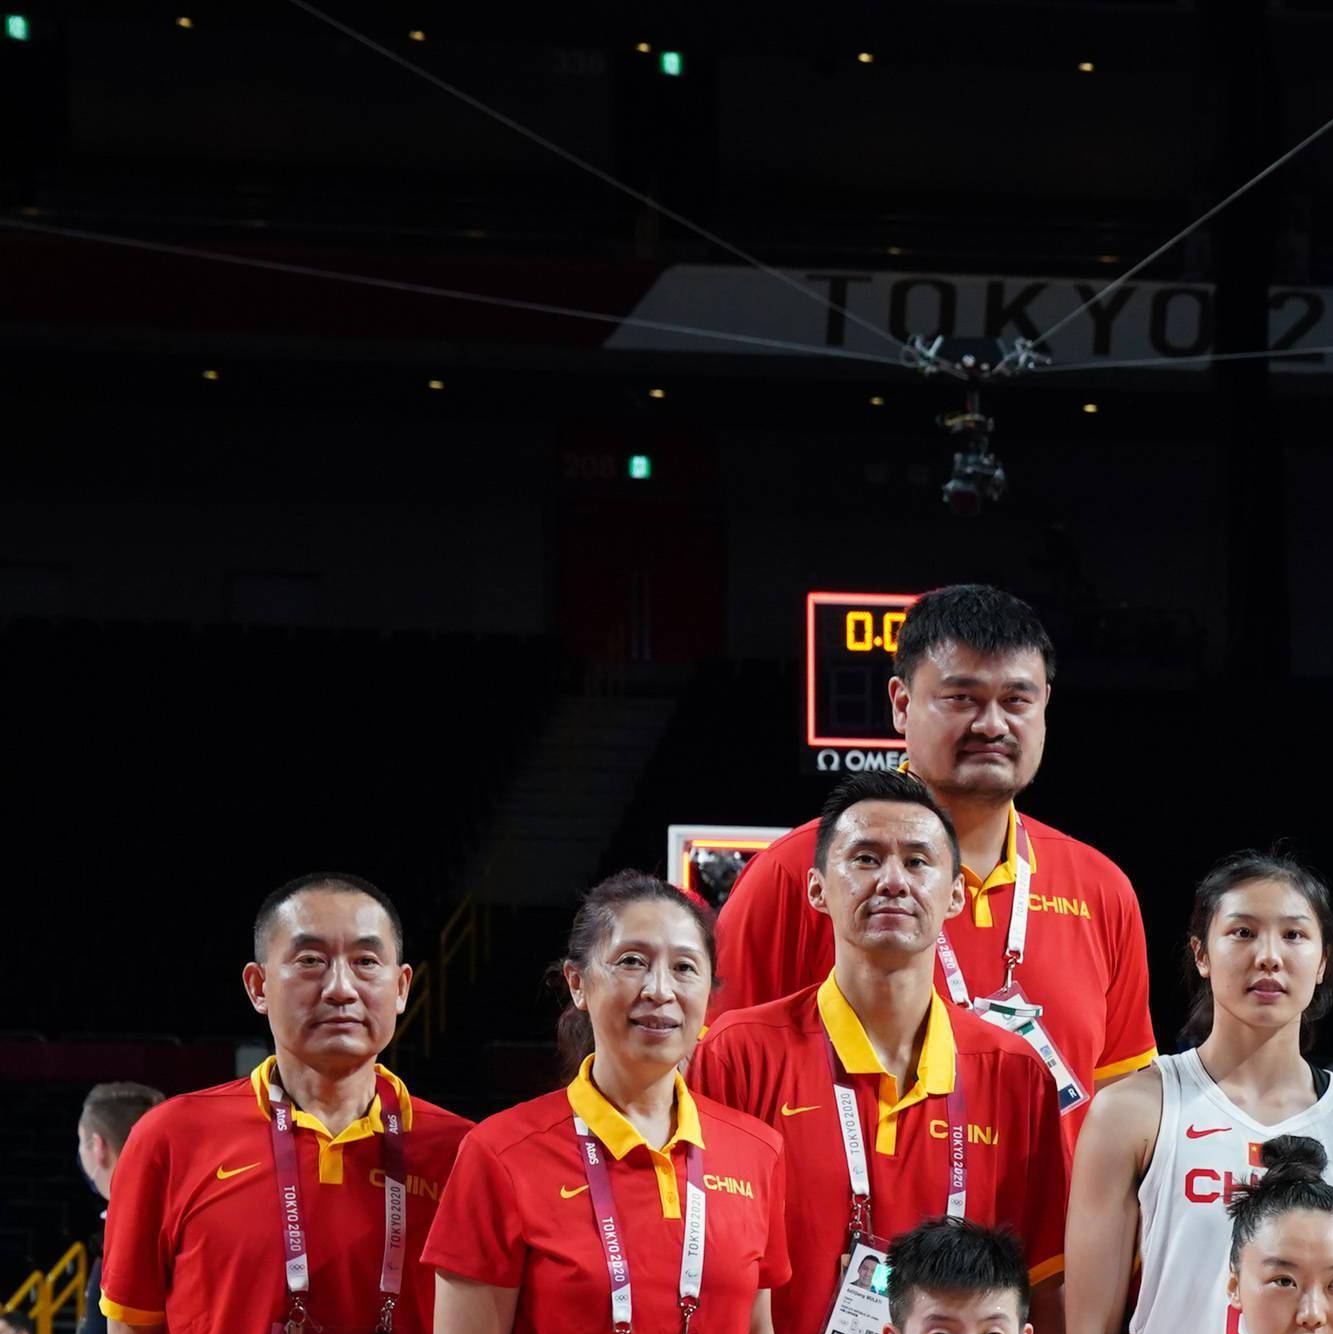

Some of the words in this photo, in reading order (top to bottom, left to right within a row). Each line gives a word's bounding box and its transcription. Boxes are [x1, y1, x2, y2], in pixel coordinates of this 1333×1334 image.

[806, 274, 1216, 358] TOKYO
[845, 749, 910, 772] OME
[1028, 893, 1091, 920] CHINA
[840, 1093, 854, 1119] 2020
[844, 1120, 860, 1155] TOKYO
[929, 1119, 999, 1145] CIN
[952, 1125, 963, 1160] TOKYO
[703, 1174, 754, 1199] CHINA
[953, 1161, 964, 1188] 2020
[284, 1185, 299, 1222] TOKYO
[391, 1186, 401, 1213] 2020
[691, 1193, 701, 1220] 2020
[288, 1223, 302, 1252] 2020
[391, 1213, 401, 1249] TOKYO
[602, 1216, 620, 1253] TOKYO
[688, 1220, 699, 1256] TOKYO
[610, 1253, 625, 1282] 2020
